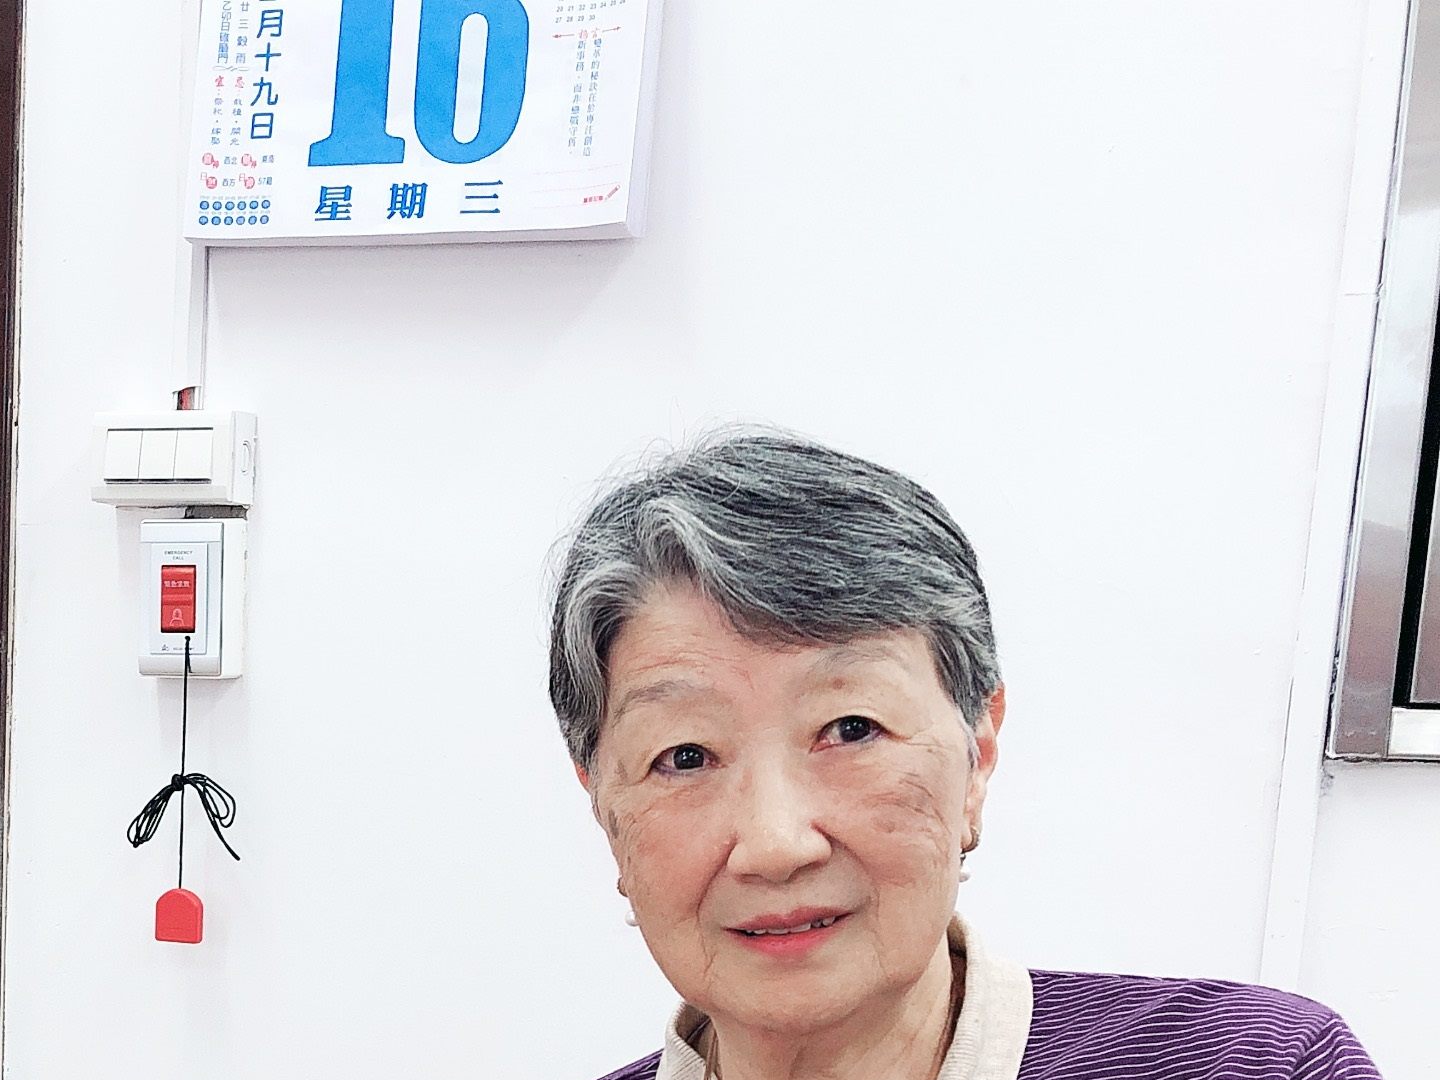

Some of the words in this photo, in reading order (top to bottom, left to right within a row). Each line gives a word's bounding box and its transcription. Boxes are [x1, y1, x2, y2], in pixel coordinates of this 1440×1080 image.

[250, 0, 284, 140] 月十九日
[314, 180, 504, 222] 星期三
